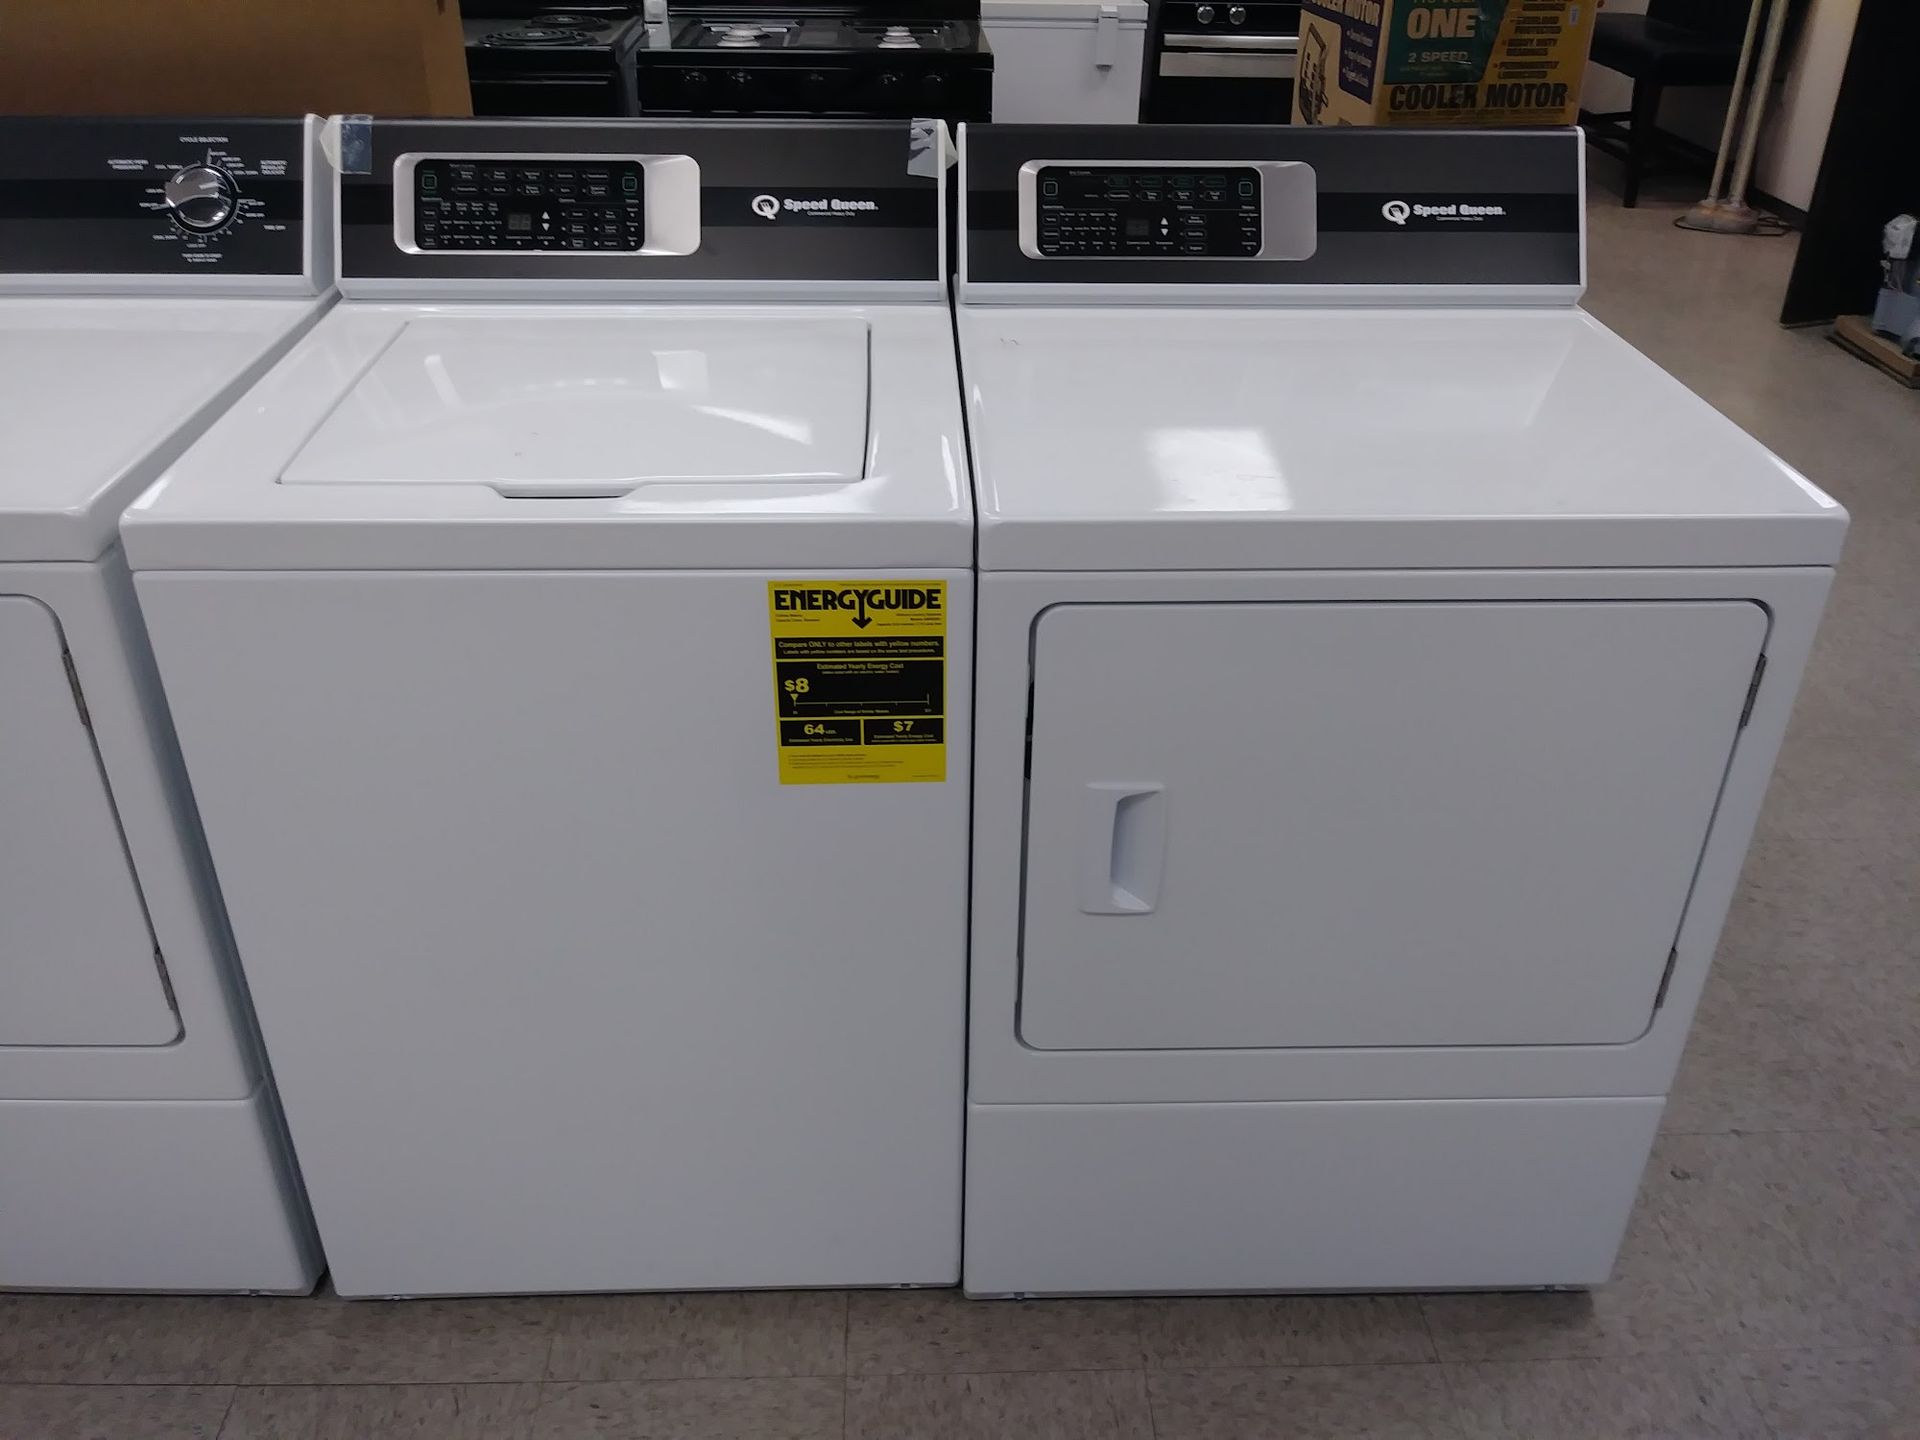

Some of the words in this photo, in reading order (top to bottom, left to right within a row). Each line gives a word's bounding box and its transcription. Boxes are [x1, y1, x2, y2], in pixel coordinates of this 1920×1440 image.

[1407, 8, 1479, 39] ONE
[1407, 53, 1418, 63] 2
[1421, 51, 1470, 63] SPEED
[1390, 84, 1478, 110] COOLER
[1486, 83, 1568, 108] MOTOR
[783, 198, 829, 212] Speed
[1412, 204, 1457, 217] Speed
[774, 589, 942, 610] ENERGYGUIDE
[778, 641, 808, 649] Compare
[785, 678, 810, 693] $8
[804, 724, 825, 735] 64
[893, 720, 914, 732] $7
